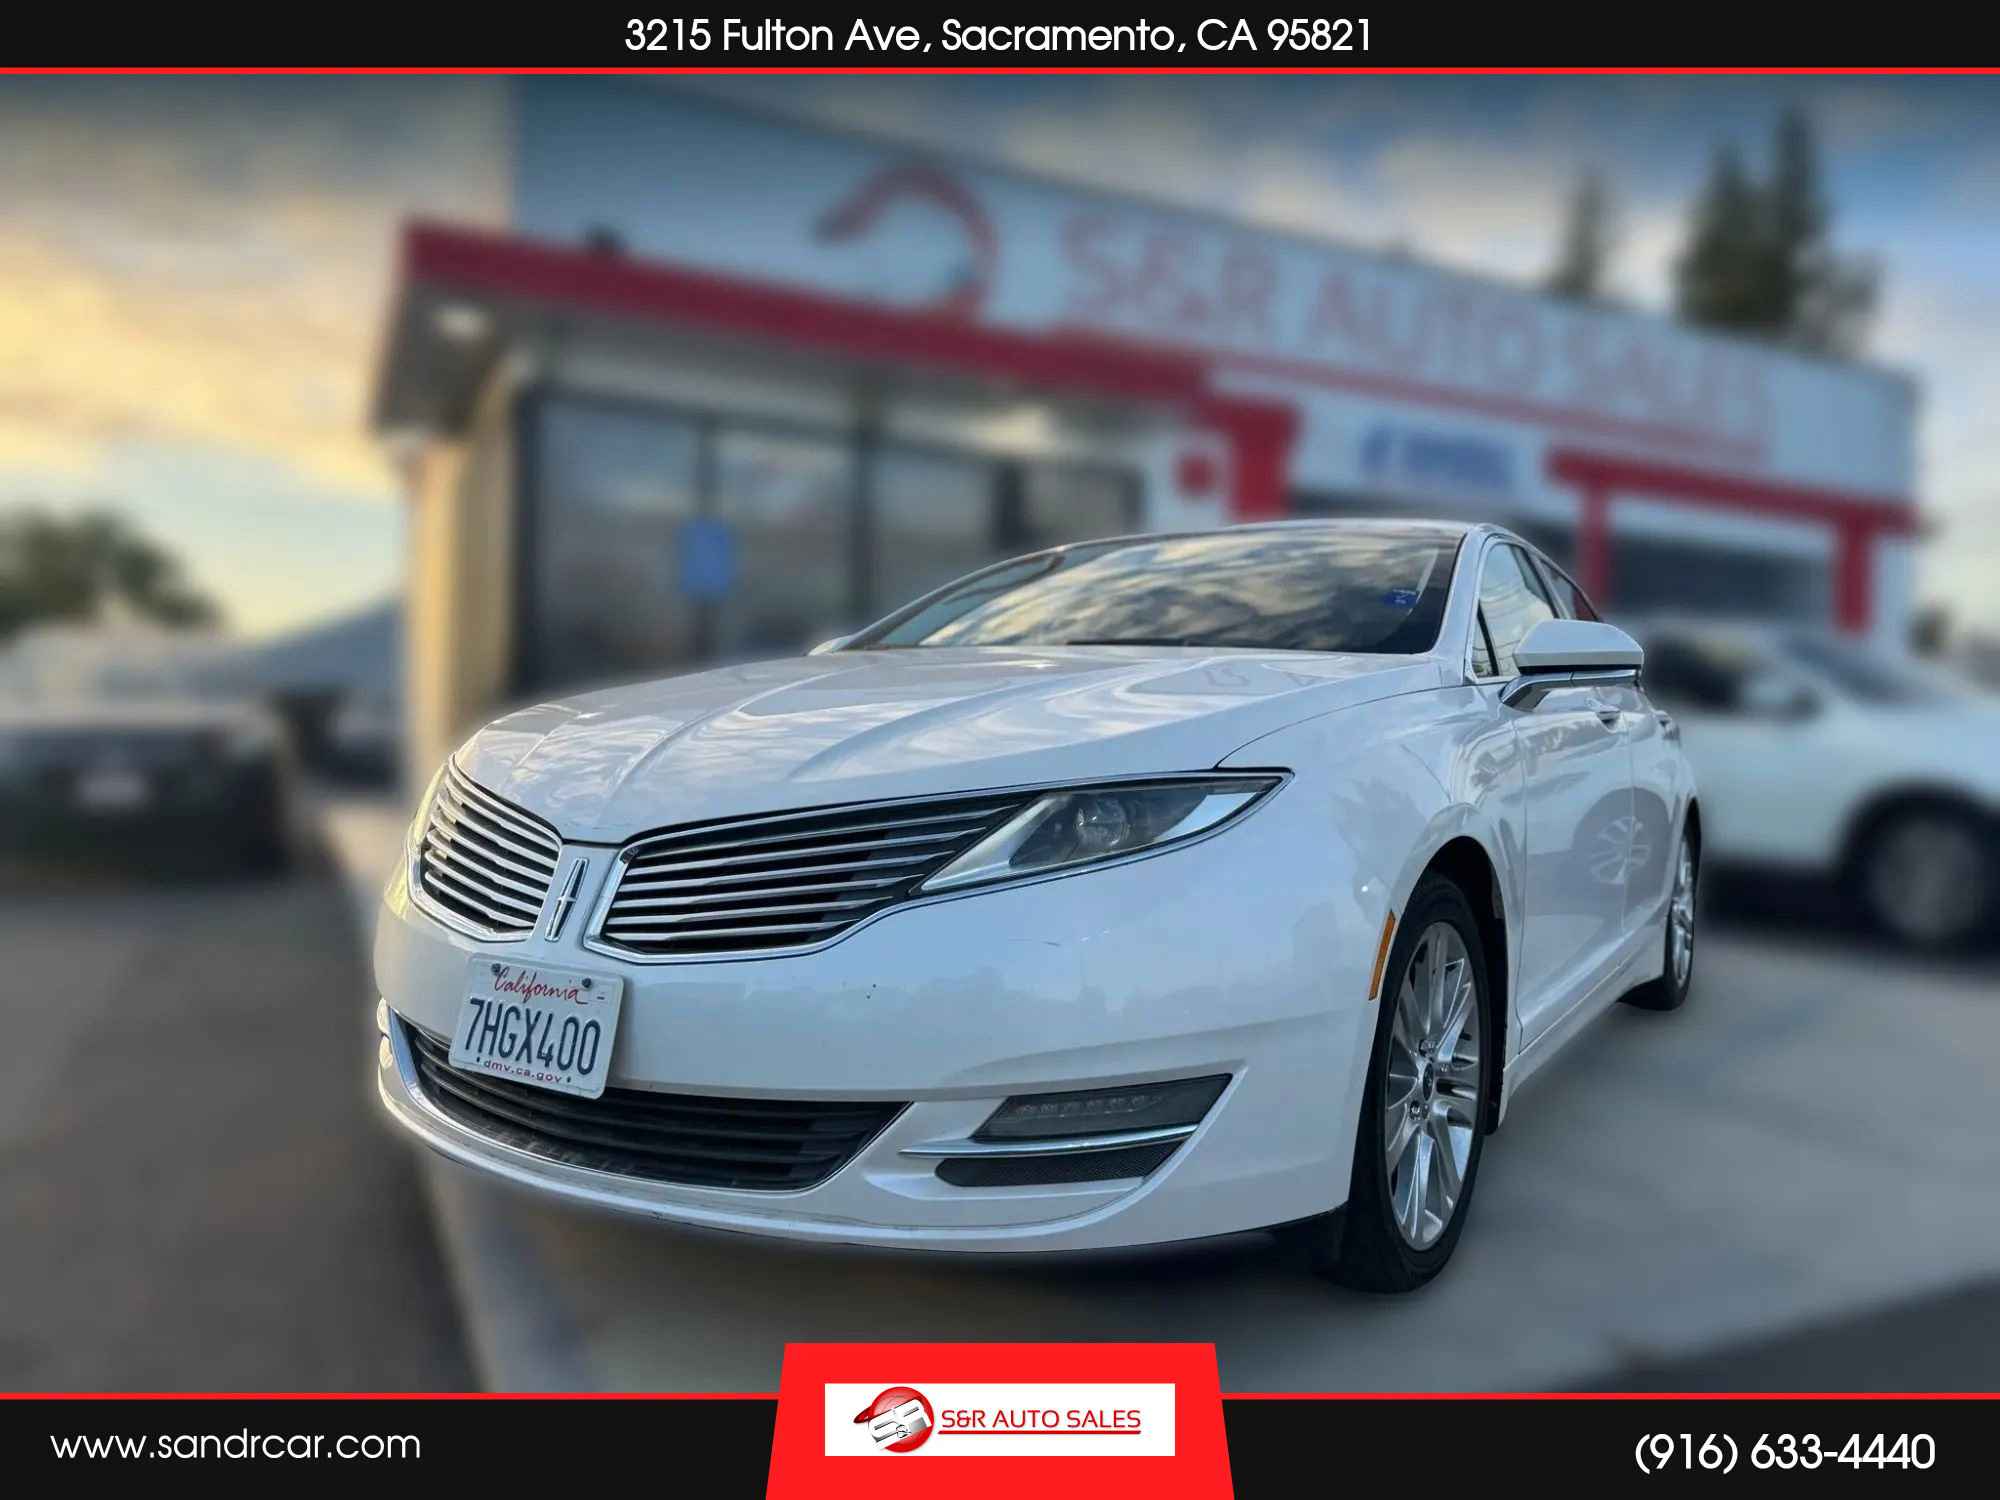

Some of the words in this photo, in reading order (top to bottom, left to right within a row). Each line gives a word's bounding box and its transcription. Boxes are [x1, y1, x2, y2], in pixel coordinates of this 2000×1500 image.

[494, 966, 588, 1005] California
[465, 997, 601, 1076] 7HGX400
[483, 1060, 563, 1083] dmv.ca.gov
